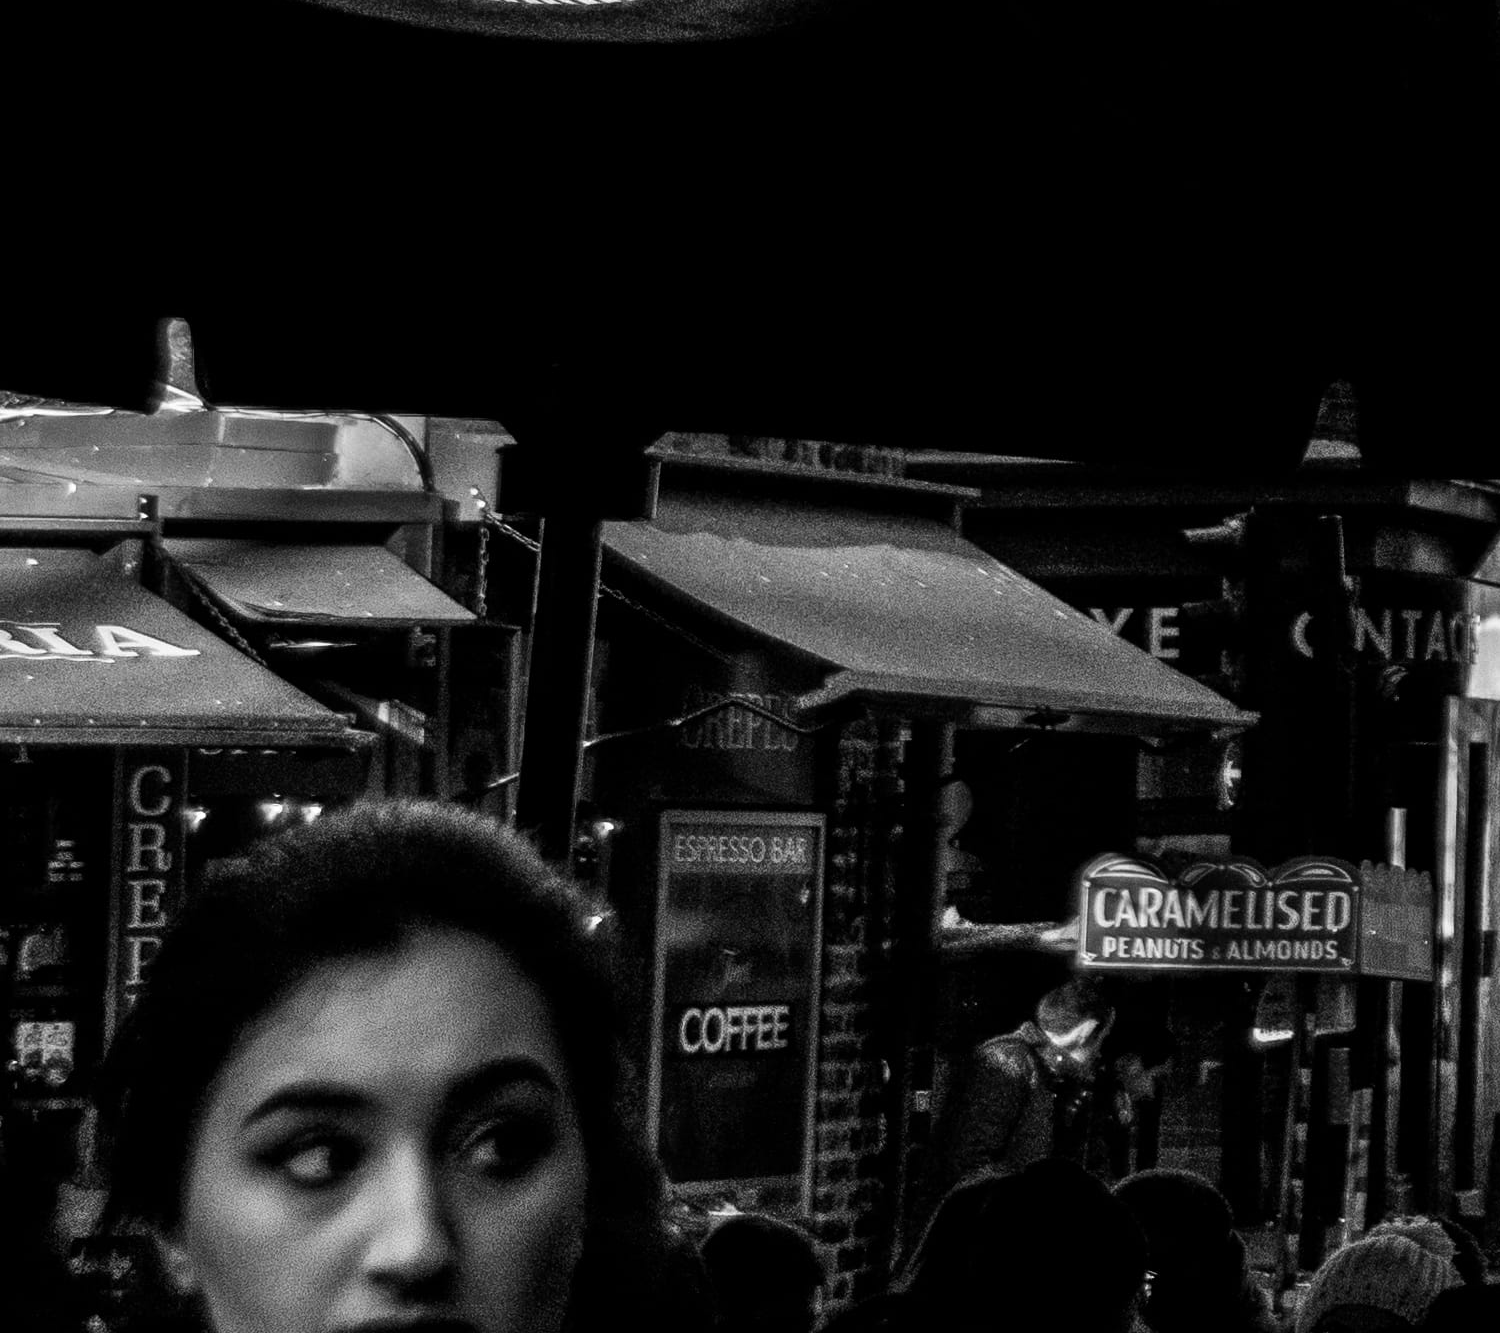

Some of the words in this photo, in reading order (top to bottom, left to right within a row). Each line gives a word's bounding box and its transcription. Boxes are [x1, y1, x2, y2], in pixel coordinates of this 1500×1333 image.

[1089, 607, 1180, 659] YE
[675, 834, 766, 864] ESPRESSO
[771, 835, 807, 864] BAR
[124, 764, 173, 1004] CREP
[1092, 887, 1352, 933] CARAMELISED
[1101, 935, 1205, 961] PEANUTS
[1226, 939, 1339, 961] ALMONDS
[679, 1005, 790, 1054] COFFEE
